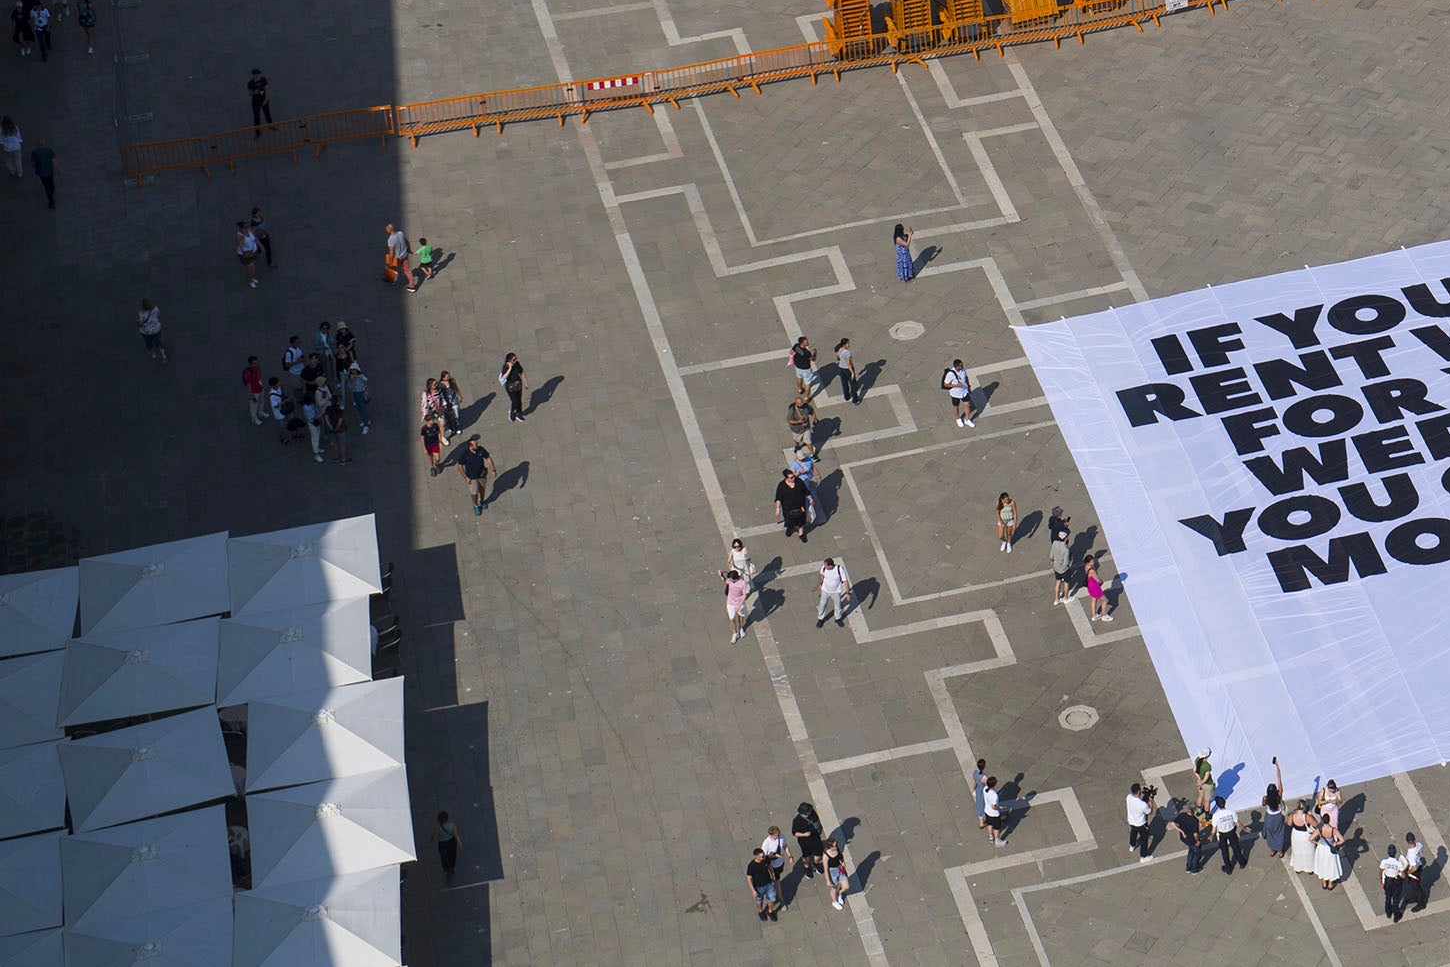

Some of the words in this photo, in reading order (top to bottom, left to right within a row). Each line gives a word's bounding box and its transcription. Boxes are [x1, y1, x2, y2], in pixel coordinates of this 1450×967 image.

[1116, 335, 1396, 427] RENT
[1151, 322, 1245, 376] IF
[1221, 378, 1447, 456] FOR
[1178, 473, 1419, 556] YOU
